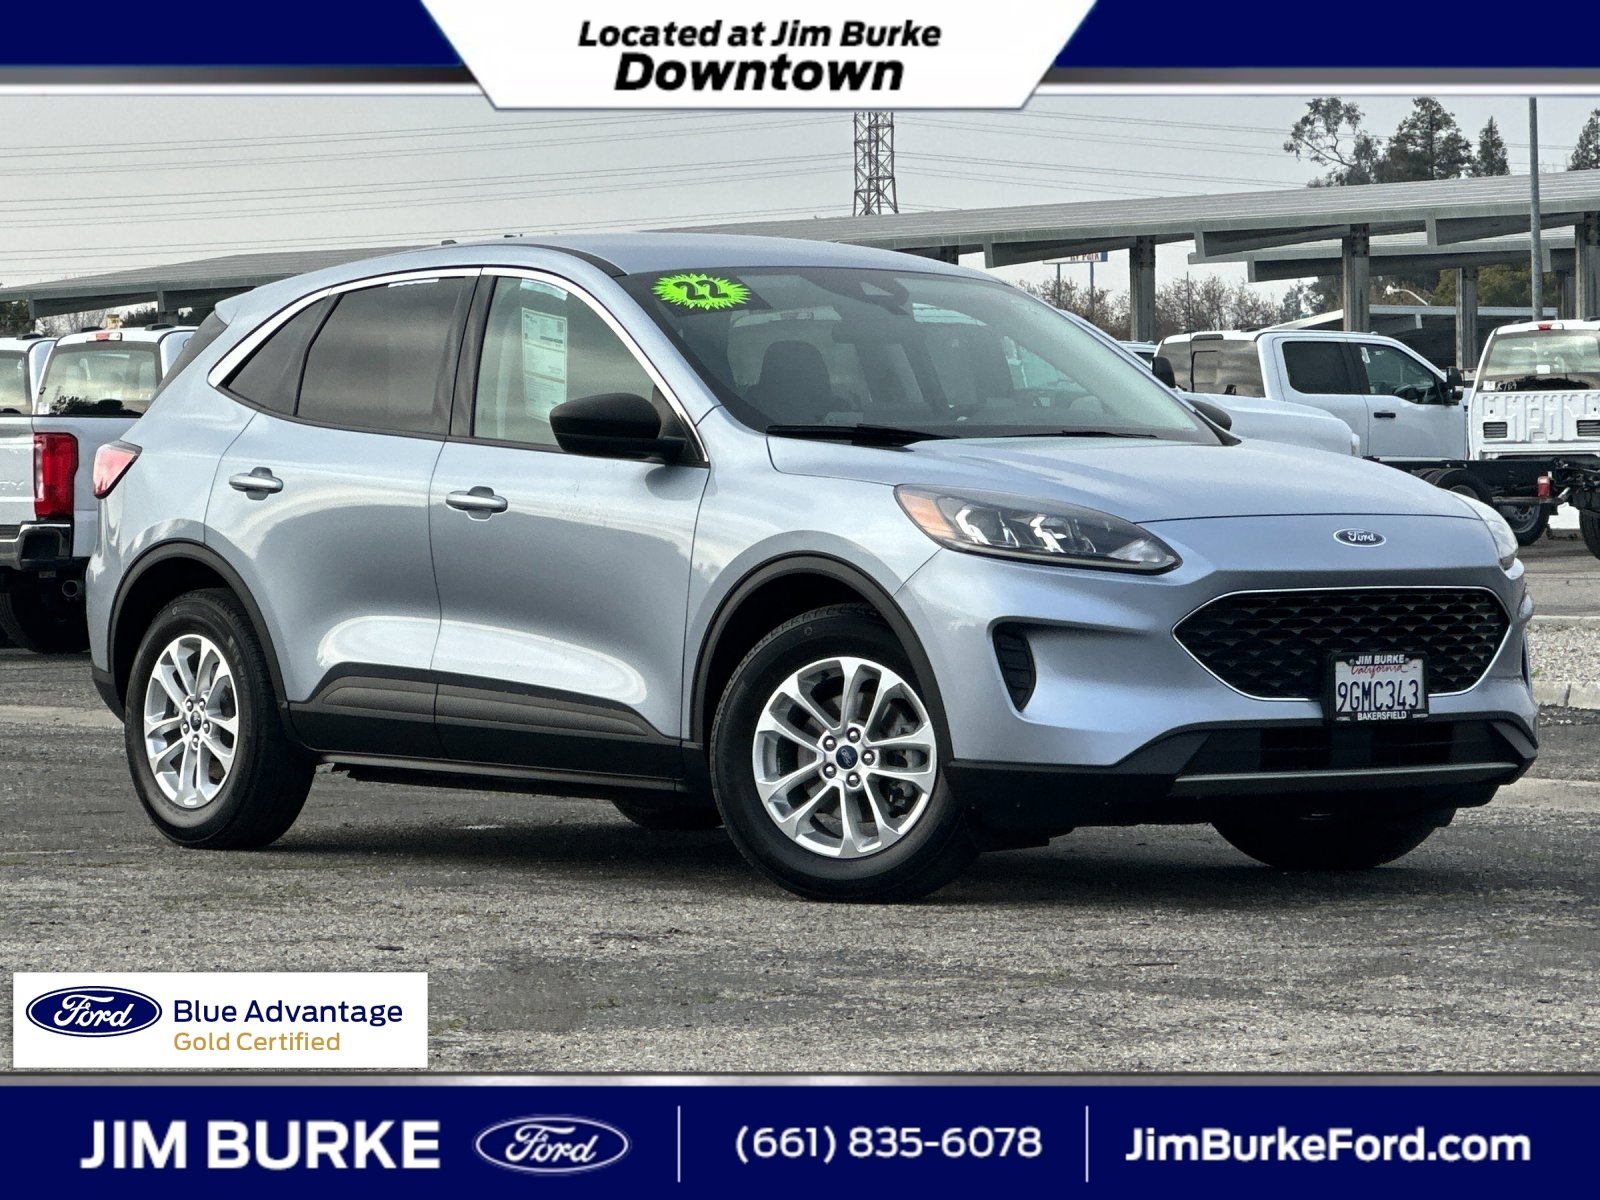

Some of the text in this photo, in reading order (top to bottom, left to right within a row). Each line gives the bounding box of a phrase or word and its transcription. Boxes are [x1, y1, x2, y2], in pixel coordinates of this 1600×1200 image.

[673, 279, 732, 301] 22
[1347, 530, 1377, 542] Ford
[1356, 654, 1405, 665] JIM BURKE
[1351, 664, 1409, 679] California
[1337, 679, 1419, 712] 9GMC343
[1357, 711, 1407, 720] BAKERSFIELD
